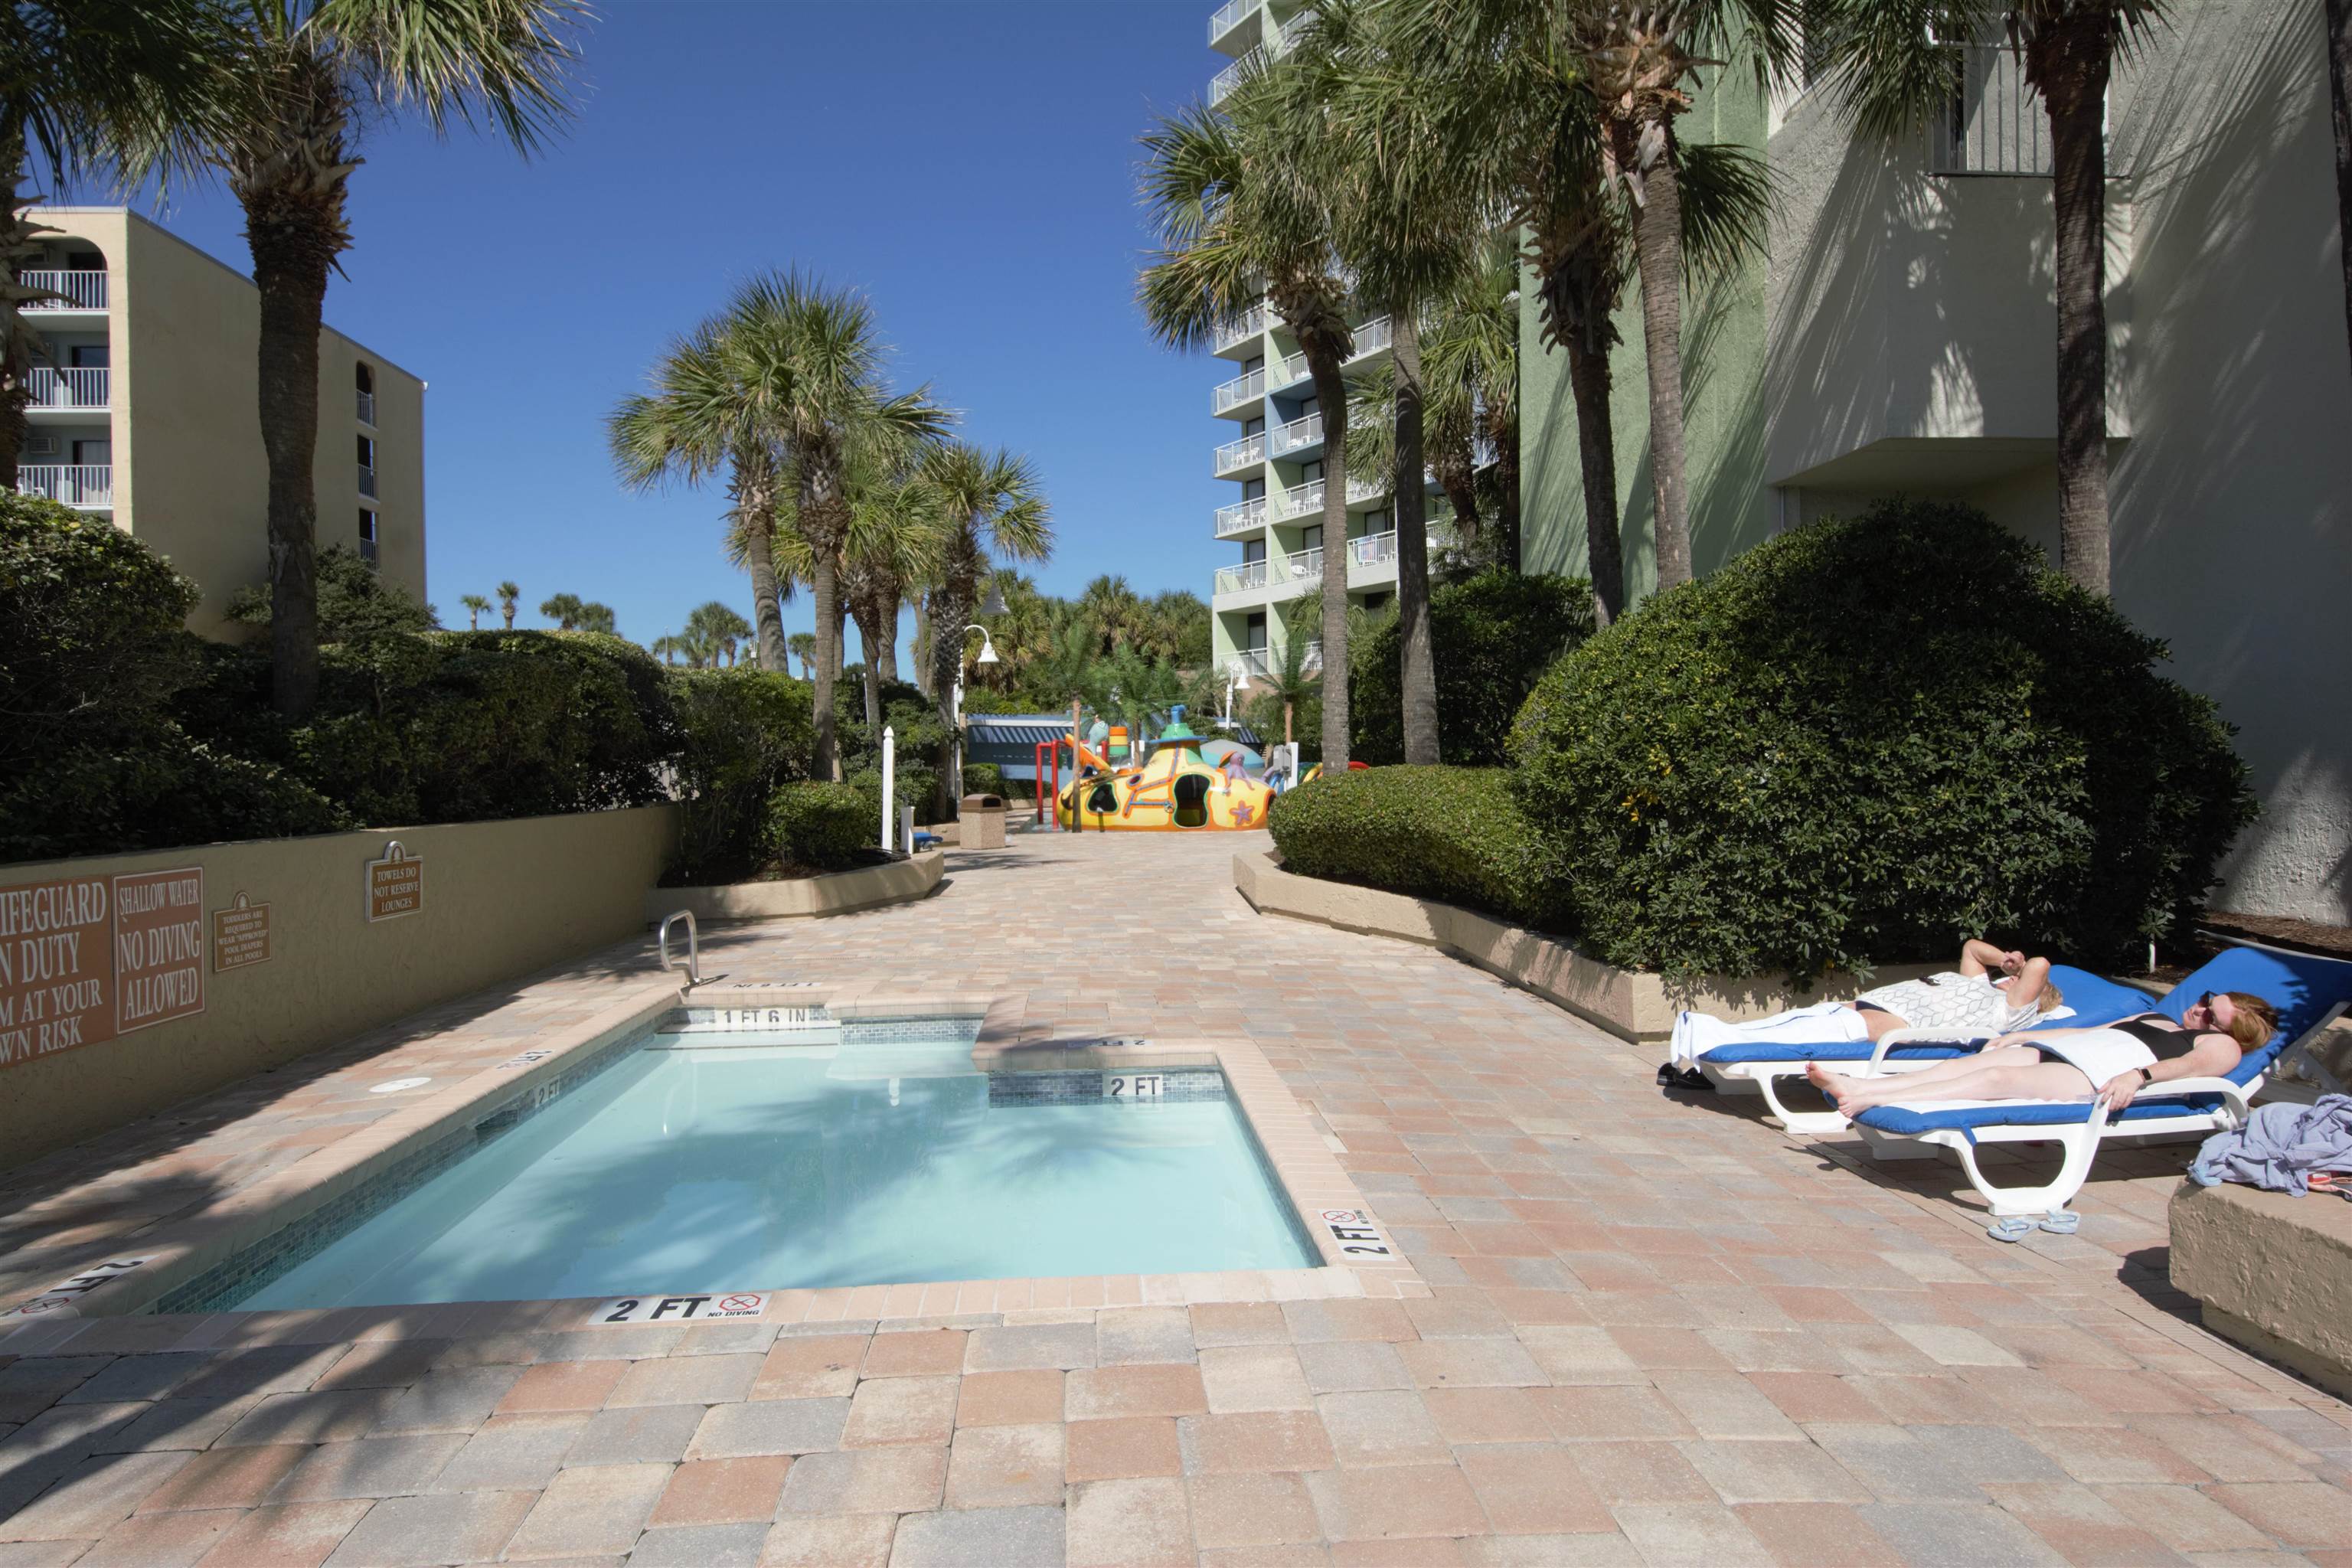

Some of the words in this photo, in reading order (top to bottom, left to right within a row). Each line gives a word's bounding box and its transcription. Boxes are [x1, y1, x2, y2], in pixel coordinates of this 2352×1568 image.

[377, 867, 404, 882] TOWELS
[406, 867, 416, 877] DO
[119, 882, 166, 916] SHALLOW
[168, 879, 199, 906] WATER
[374, 886, 390, 899] NOT
[390, 881, 420, 895] RESERVE
[381, 897, 412, 913] LOUNGES
[253, 910, 263, 919] ARE
[224, 922, 253, 934] REQUIRED
[254, 920, 262, 929] TO
[119, 930, 144, 973] NO
[148, 920, 201, 966] DIVING
[218, 936, 235, 945] WEAR
[224, 945, 239, 955] POOL
[240, 940, 263, 952] DIAPERS
[20, 932, 80, 983] DUTY
[233, 954, 243, 964] ALL
[245, 951, 263, 961] POOLS
[21, 989, 47, 1024] AT
[51, 978, 103, 1015] YOUR
[124, 967, 198, 1021] ALLOWED
[724, 1010, 732, 1024] 1
[742, 1010, 760, 1023] FT
[768, 1009, 779, 1023] 6
[789, 1008, 805, 1022] IN
[38, 1015, 83, 1054] RISK
[539, 1087, 545, 1105] 2
[548, 1078, 559, 1099] FT
[1111, 1078, 1125, 1096] 2
[1135, 1076, 1159, 1095] FT
[1330, 1225, 1380, 1240] FT
[1344, 1246, 1390, 1255] 2
[48, 1274, 120, 1292] FT
[605, 1299, 639, 1322] 2
[649, 1297, 711, 1319] FT
